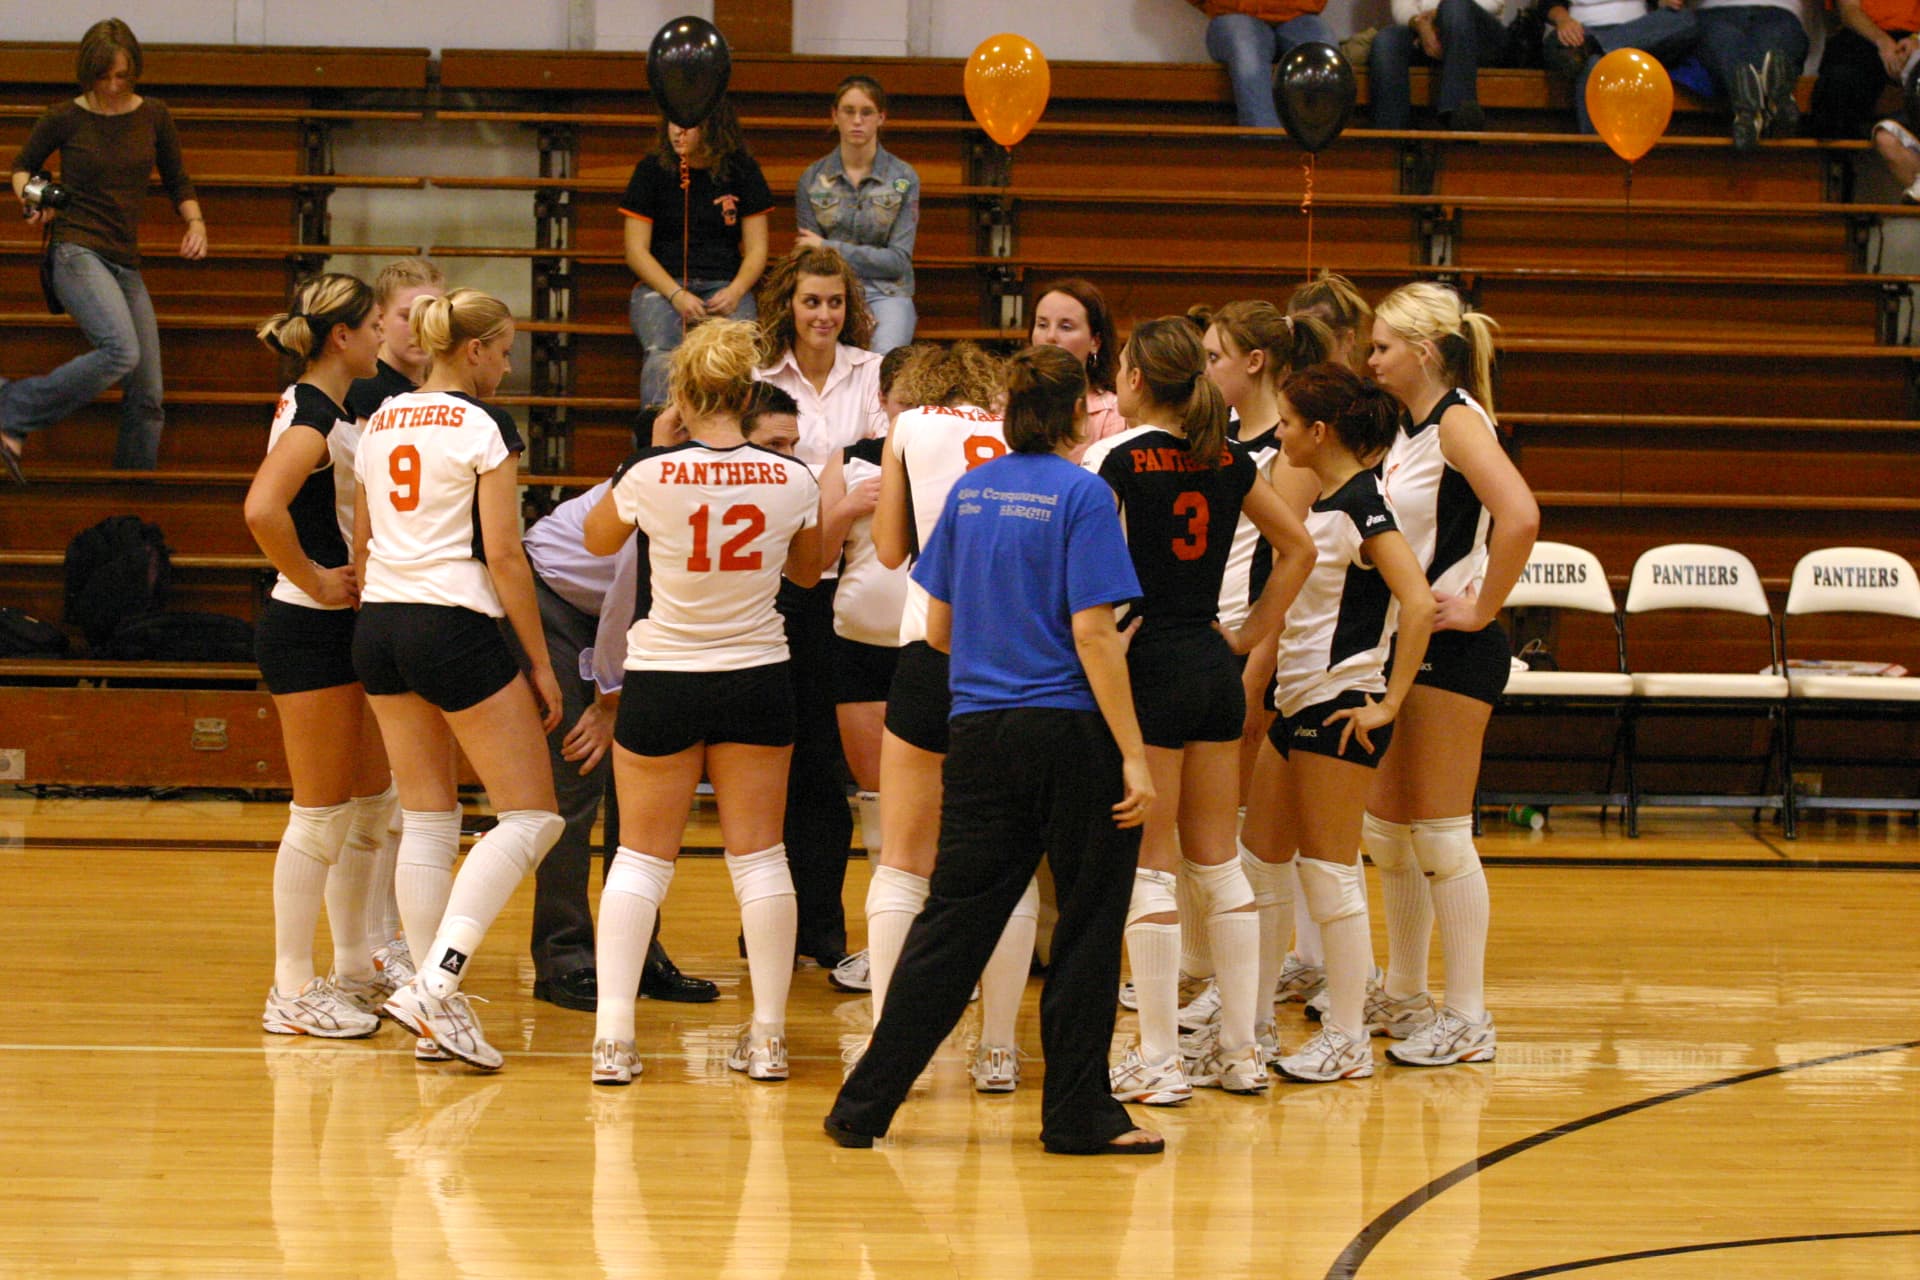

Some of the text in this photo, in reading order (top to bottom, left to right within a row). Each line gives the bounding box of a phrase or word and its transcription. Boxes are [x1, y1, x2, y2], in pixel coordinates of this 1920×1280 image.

[369, 404, 467, 435] PANTHERS
[921, 405, 1007, 422] PANTHE
[388, 444, 422, 512] 9
[658, 461, 789, 486] PANTHERS
[687, 503, 766, 572] 12
[1171, 491, 1210, 561] 3
[1519, 563, 1587, 584] NTHERS
[1652, 564, 1738, 586] PANTHERS
[1812, 564, 1899, 588] PANTHERS
